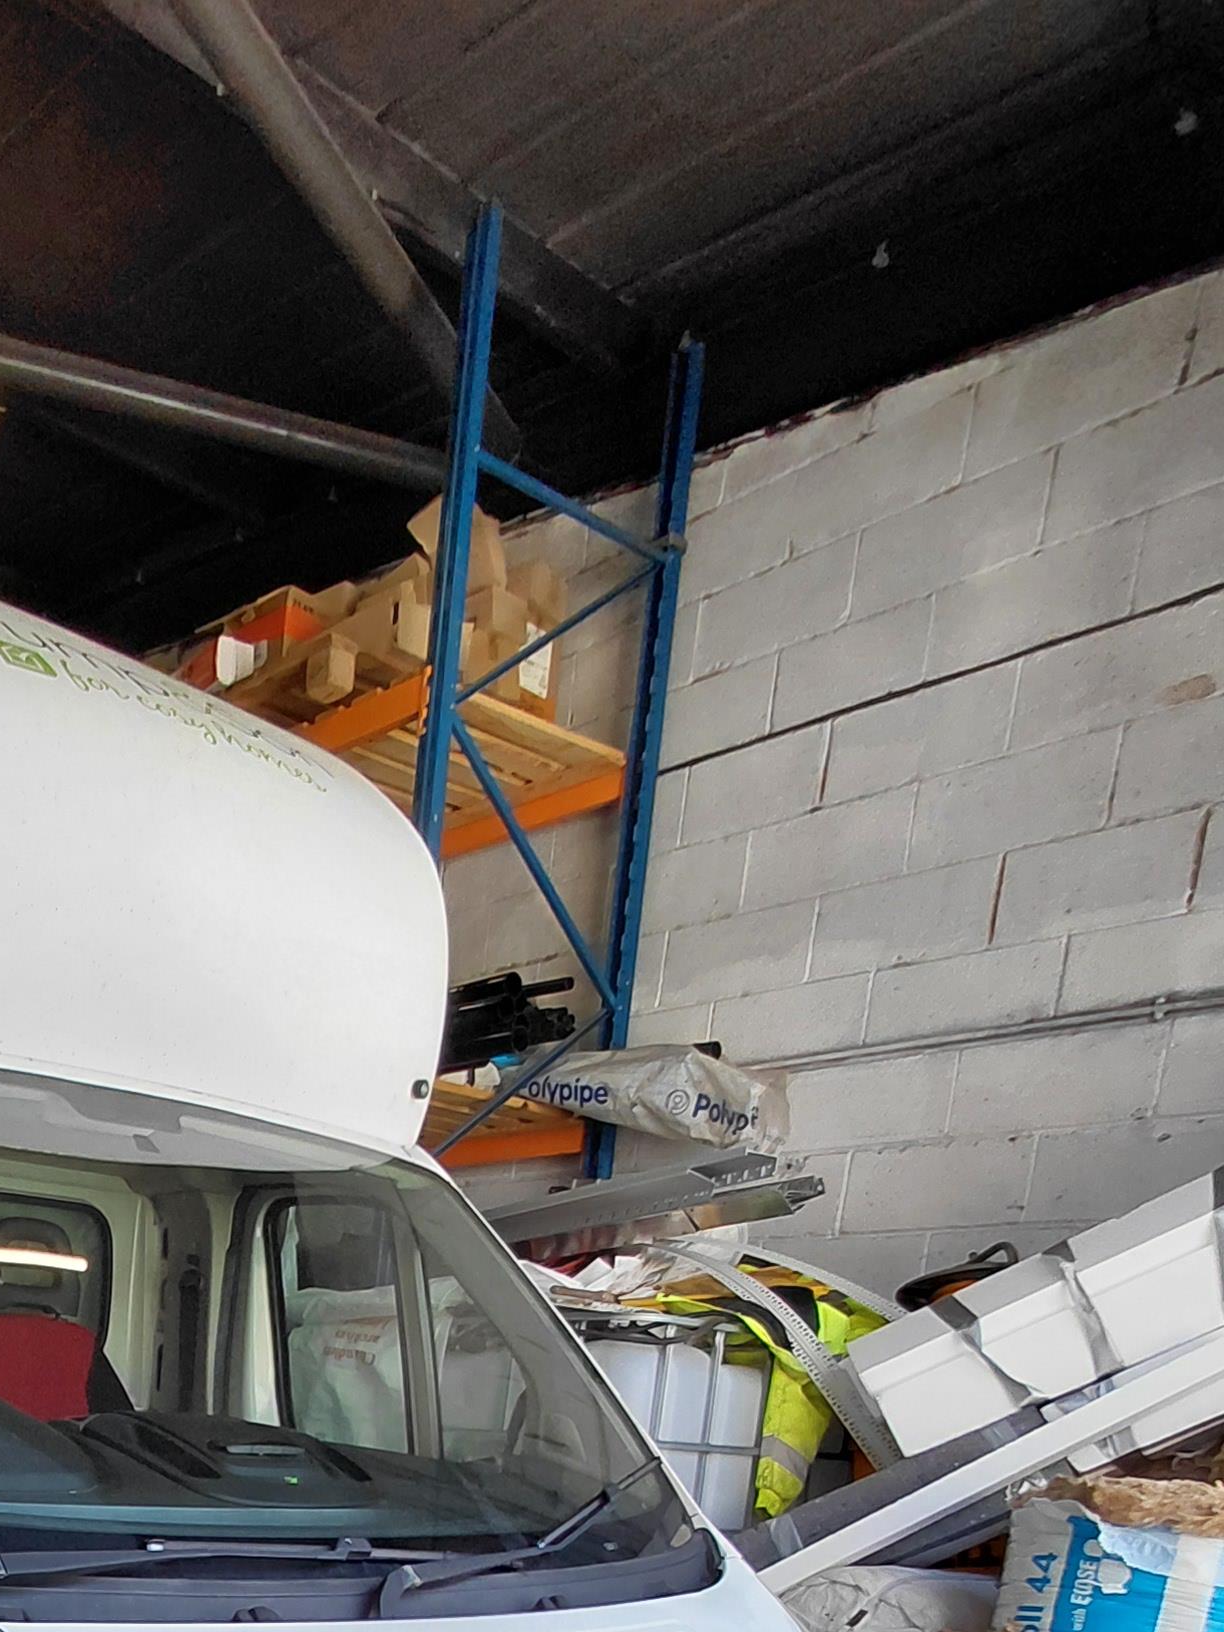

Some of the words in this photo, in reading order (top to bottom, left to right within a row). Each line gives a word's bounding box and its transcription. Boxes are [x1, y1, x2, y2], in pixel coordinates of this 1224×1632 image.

[528, 1075, 608, 1108] olypipe
[1026, 1552, 1058, 1593] 44
[1070, 1608, 1087, 1631] with
